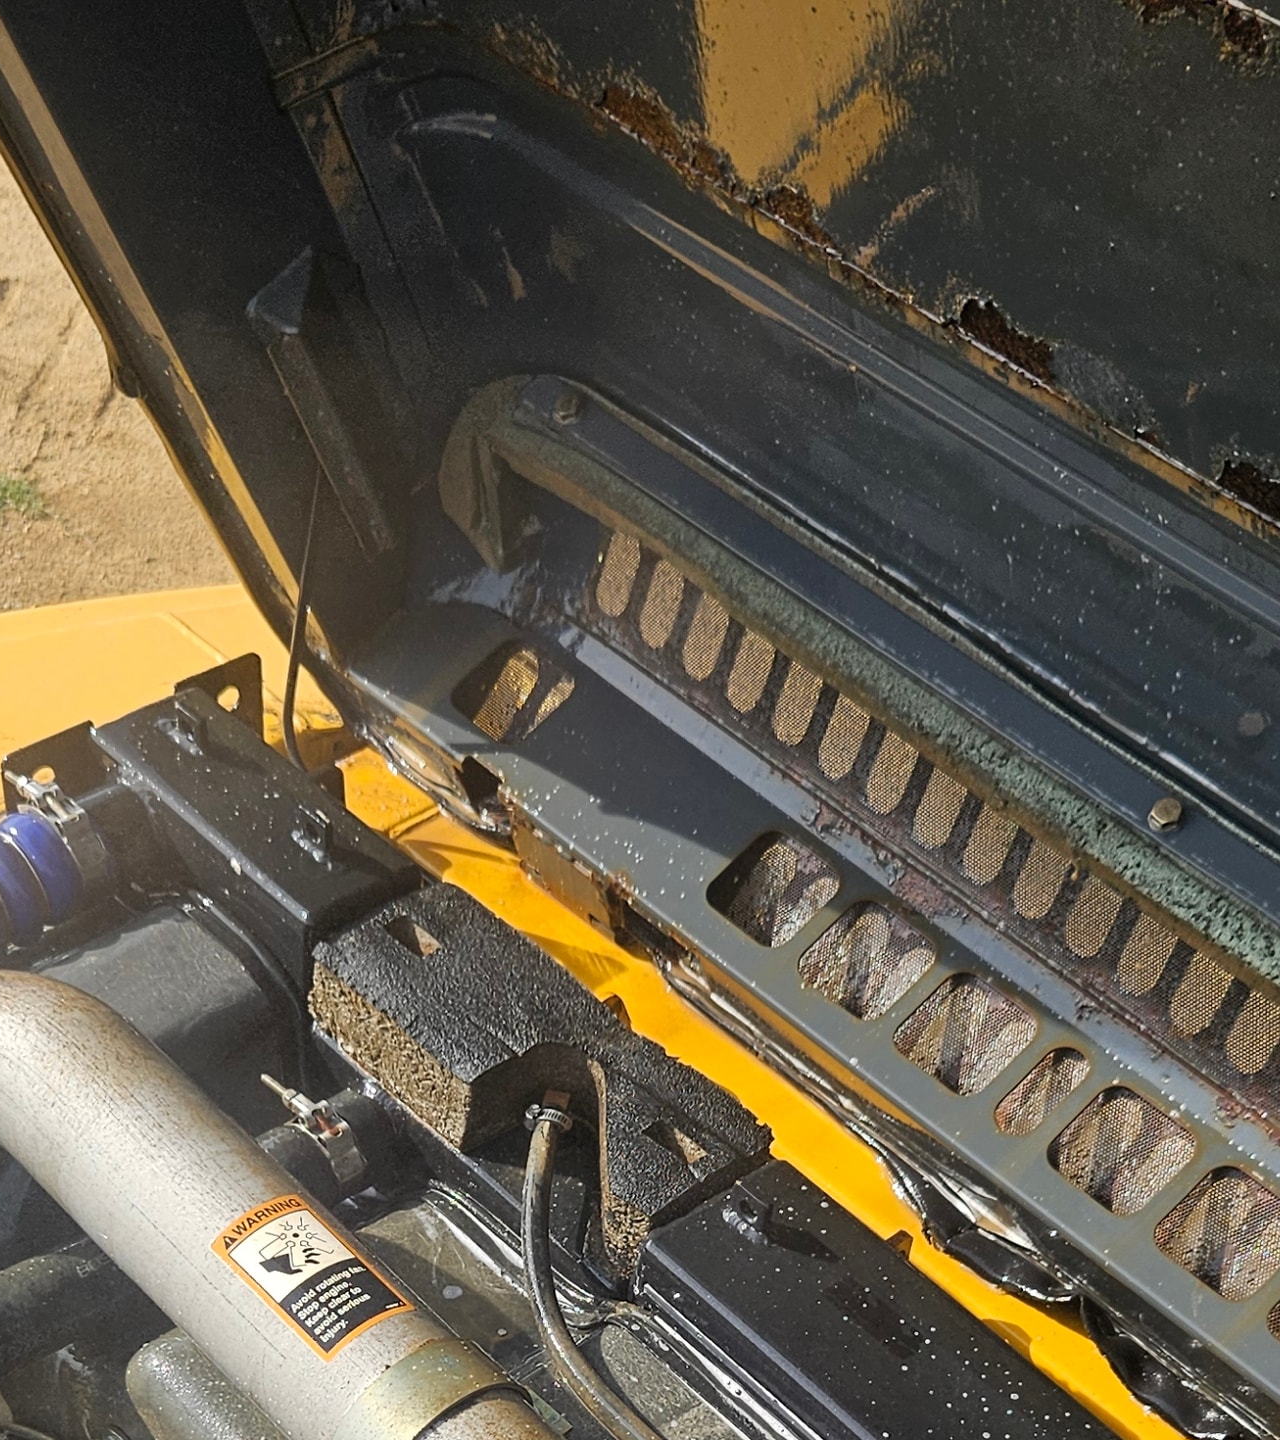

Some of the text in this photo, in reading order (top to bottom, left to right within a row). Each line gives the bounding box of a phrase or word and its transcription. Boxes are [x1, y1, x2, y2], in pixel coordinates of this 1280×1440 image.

[231, 1198, 302, 1236] WARNING
[291, 1288, 317, 1313] Avoid
[315, 1270, 352, 1292] rotating
[297, 1281, 353, 1320] Stop engine.
[304, 1286, 362, 1328] Keep clear to
[313, 1293, 371, 1335] avoid serious
